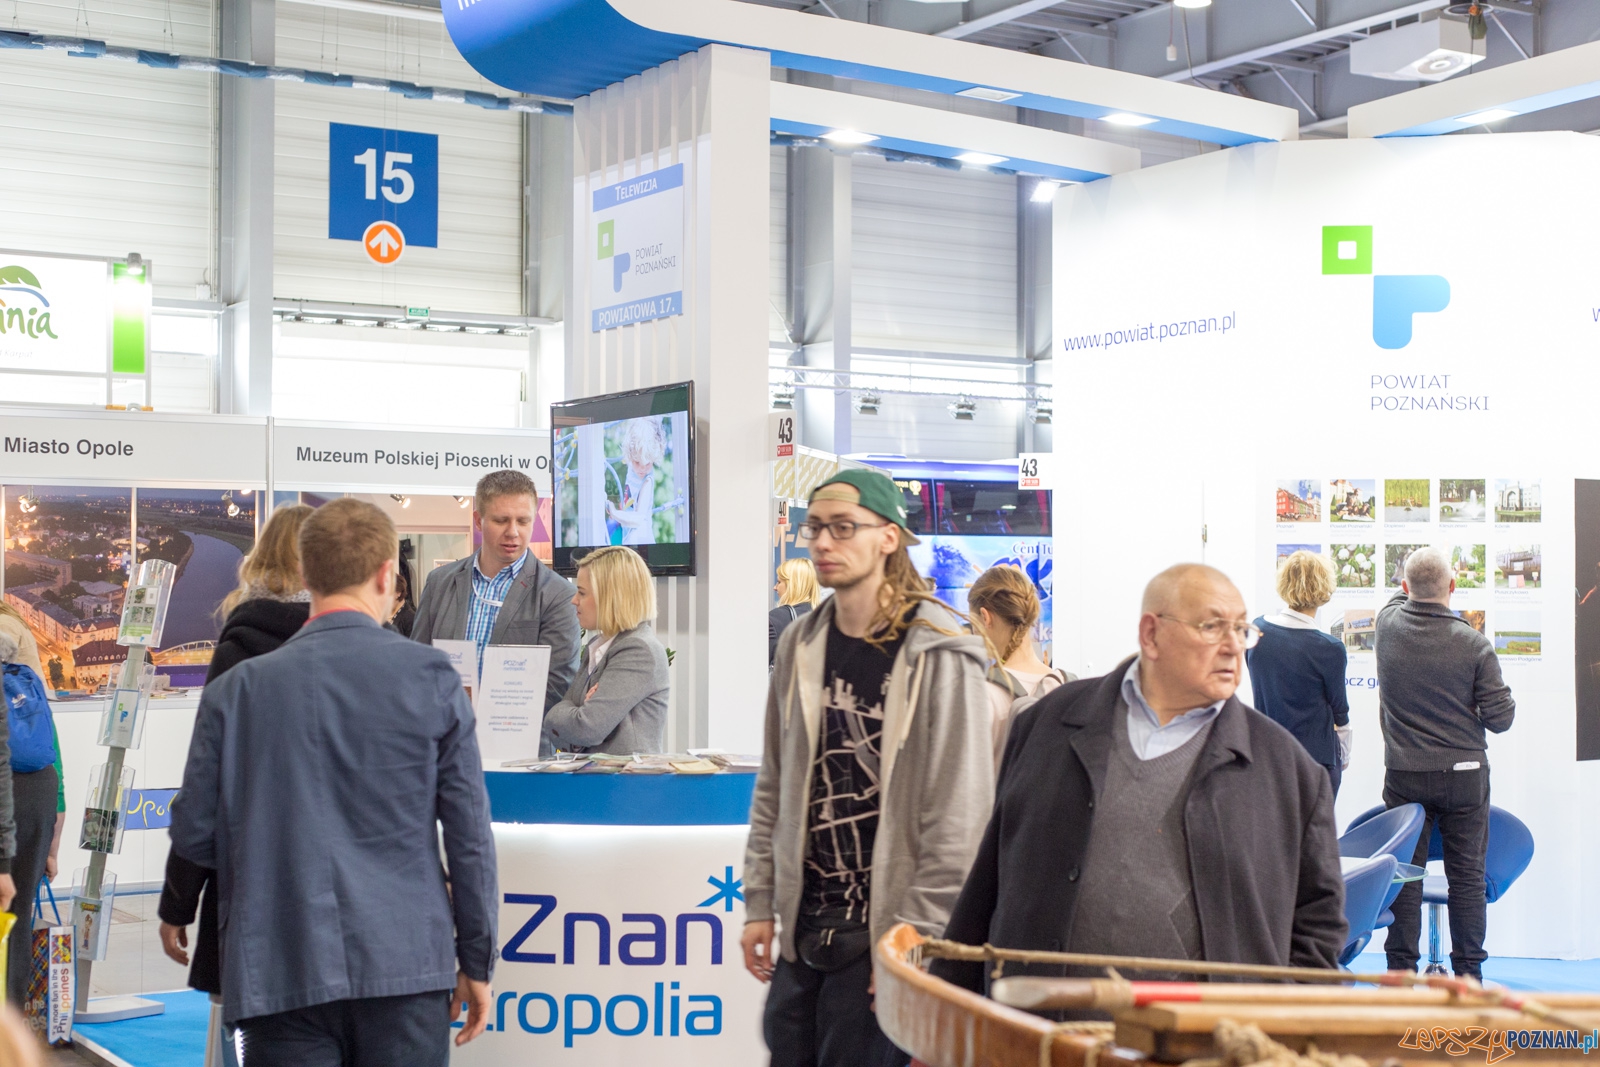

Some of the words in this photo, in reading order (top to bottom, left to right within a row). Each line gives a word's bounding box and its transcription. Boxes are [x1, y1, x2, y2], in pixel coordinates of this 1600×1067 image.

[354, 148, 415, 204] 15
[635, 243, 663, 260] POWIAT
[635, 255, 677, 275] POZNAŃSKI
[599, 301, 657, 326] POWIATOWA
[659, 297, 675, 315] 17.
[1063, 311, 1236, 350] www.powiat.poznan.pl
[1371, 375, 1451, 389] POWIAT
[1371, 392, 1490, 411] POZNAŃSKI
[778, 417, 793, 443] 43
[4, 436, 70, 454] Miasto
[76, 439, 134, 459] Opole
[296, 446, 369, 464] Muzeum
[374, 450, 439, 469] Polskiej
[444, 452, 513, 468] Piosenki
[518, 458, 530, 469] w
[1021, 458, 1038, 477] 43
[778, 501, 787, 516] 40
[51, 990, 59, 1002] fun
